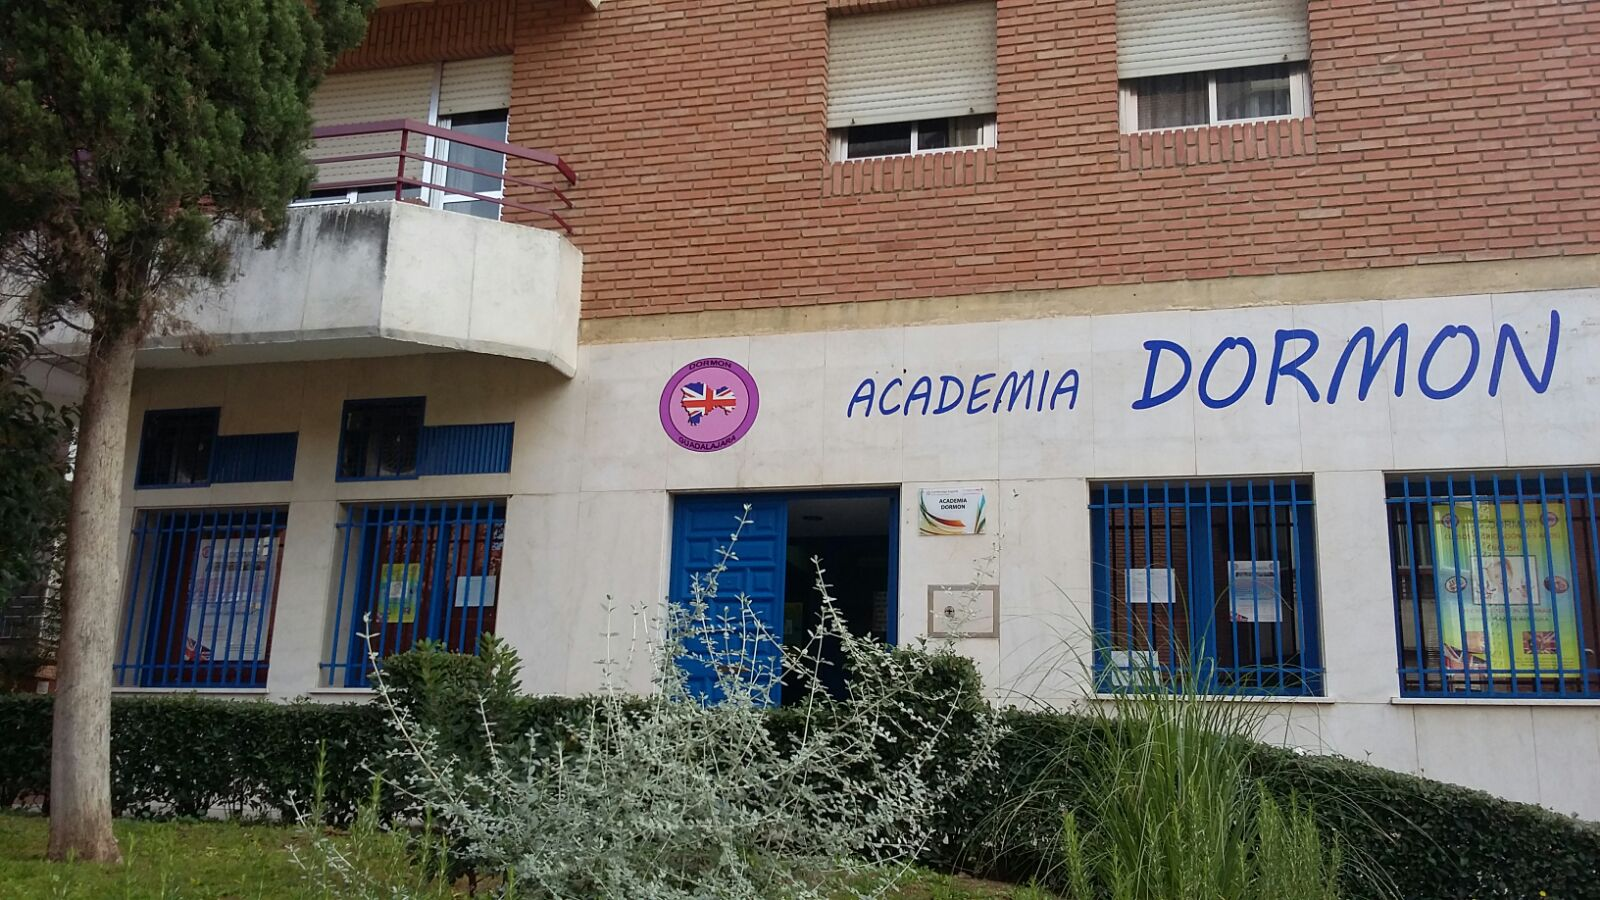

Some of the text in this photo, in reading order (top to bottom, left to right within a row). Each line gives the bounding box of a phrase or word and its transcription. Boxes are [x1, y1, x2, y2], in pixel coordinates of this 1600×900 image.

[689, 361, 732, 370] DORMON
[847, 310, 1561, 418] ACADEMIA DORMON
[678, 435, 736, 451] GUADALAJARA
